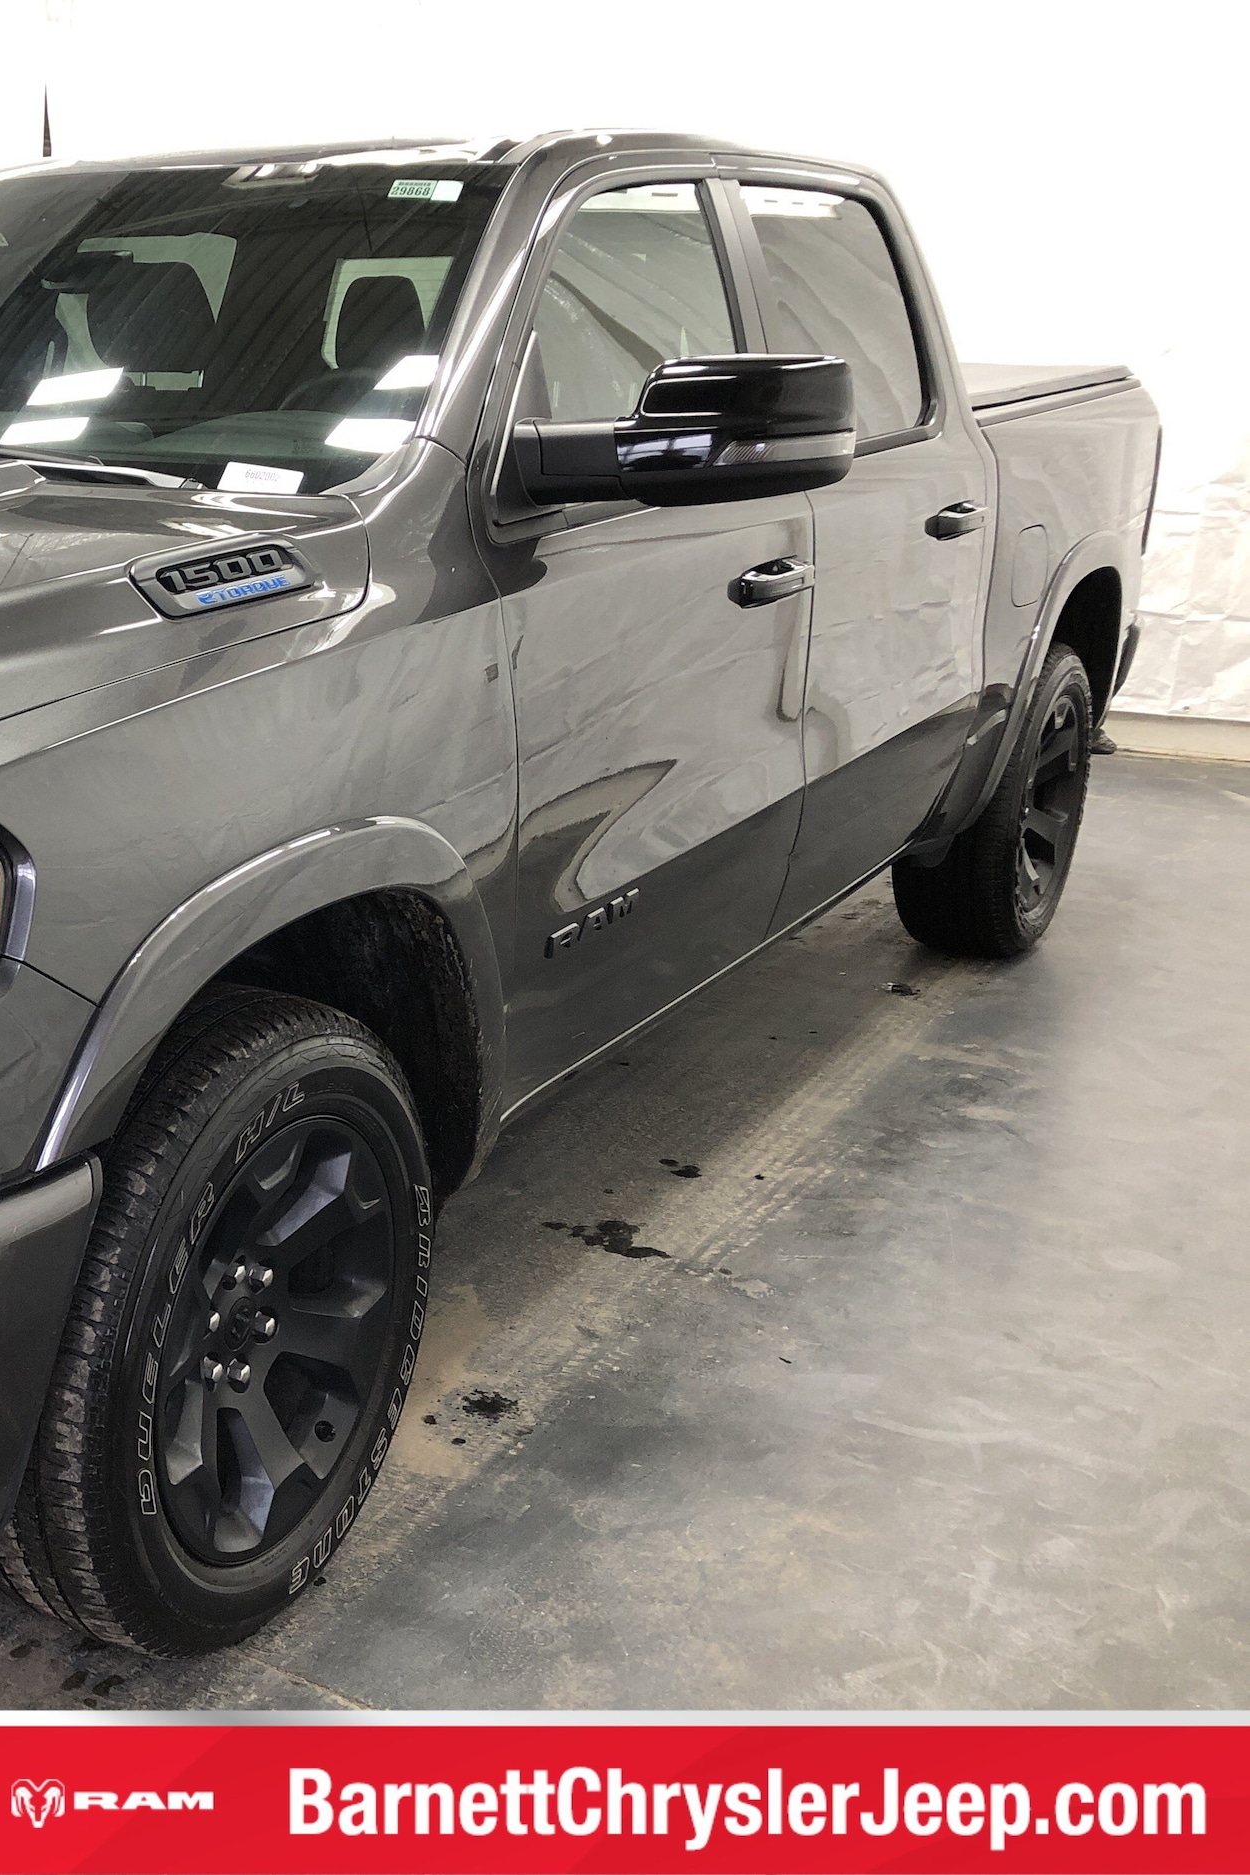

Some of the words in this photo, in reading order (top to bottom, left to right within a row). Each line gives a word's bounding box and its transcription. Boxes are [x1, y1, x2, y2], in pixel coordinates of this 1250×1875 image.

[390, 186, 431, 196] 29868
[160, 549, 285, 592] 1500
[543, 887, 640, 960] RAM
[137, 1181, 215, 1516] DUELER
[288, 1183, 432, 1595] BRIDGESTONE
